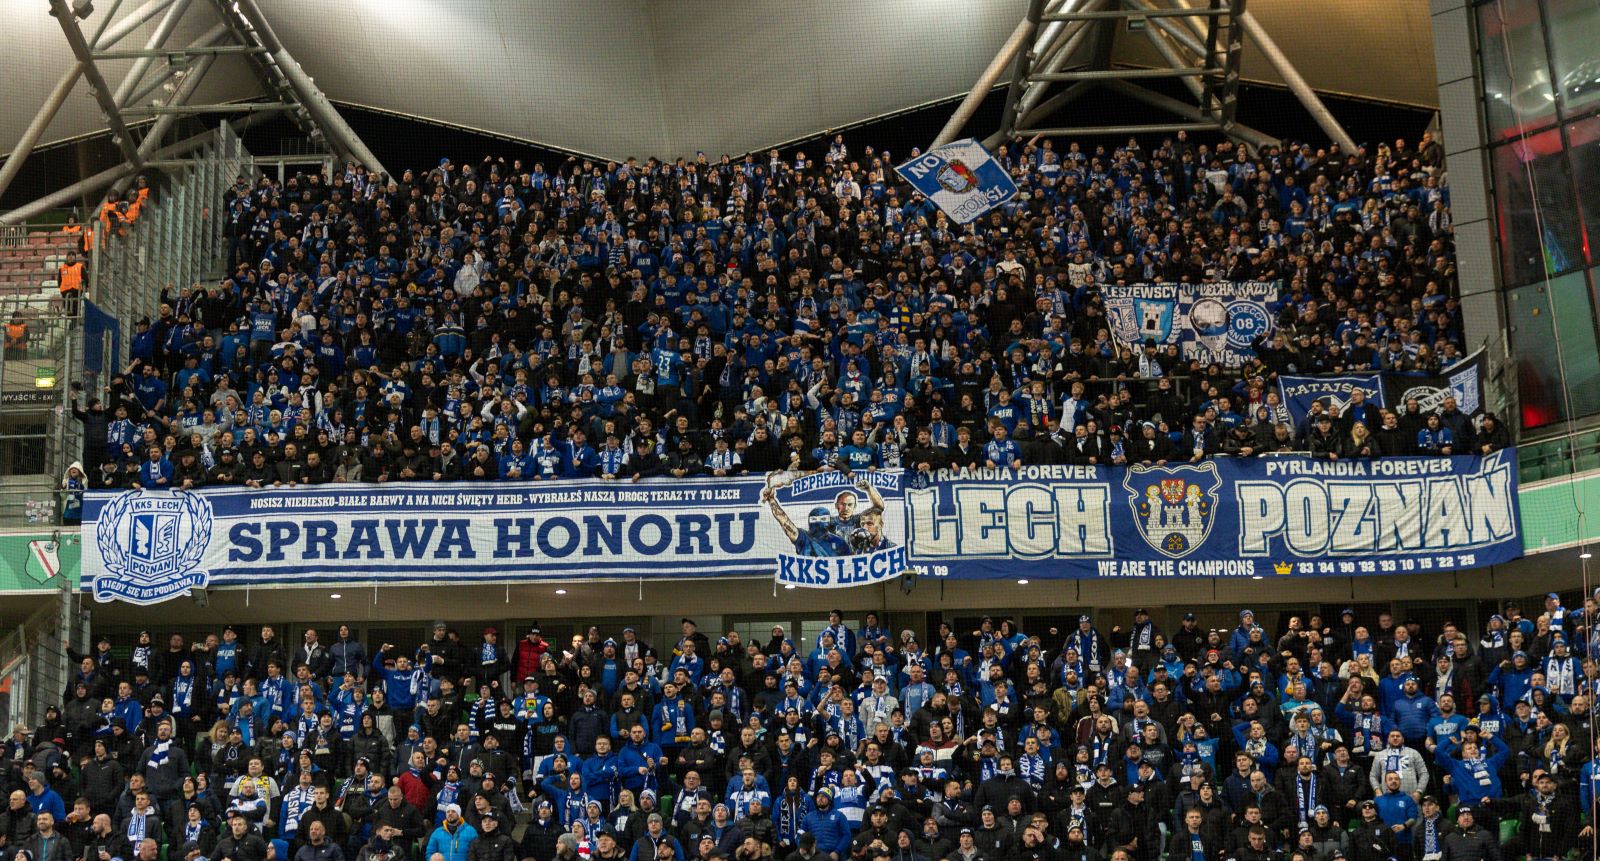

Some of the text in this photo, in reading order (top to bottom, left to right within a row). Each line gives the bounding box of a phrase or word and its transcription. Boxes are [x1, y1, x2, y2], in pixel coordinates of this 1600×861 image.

[1236, 318, 1254, 330] 08
[658, 355, 671, 373] 23
[928, 465, 1098, 482] YRLANDIA FOREVER
[1266, 458, 1453, 476] PYRLANDIA FOREVER
[134, 501, 179, 510] KKS LECH
[250, 497, 283, 509] NOSISZ
[284, 495, 368, 508] NIEBIESKO-BIAŁE
[370, 495, 405, 506] BARWY
[406, 495, 414, 505] A
[415, 495, 430, 505] NA
[431, 494, 455, 505] NICH
[457, 492, 494, 506] ŚWIĘTY
[496, 494, 523, 505] HERB
[529, 490, 582, 504] WYBRAŁEŚ
[584, 490, 616, 504] NASZĄ
[618, 491, 649, 504] DROGĘ
[650, 490, 683, 502] TERAZ
[683, 490, 698, 501] TY
[699, 489, 713, 500] TO
[714, 488, 741, 500] LECH
[1235, 449, 1516, 559] POZNAŃ
[905, 483, 1114, 560] LECH
[228, 511, 760, 562] SPRAWA HONORU
[778, 546, 906, 585] KKS LECH
[932, 565, 949, 577] '09
[1097, 559, 1255, 577] WE ARE THE CHAMPIONS
[1296, 553, 1476, 574] '83 '84 '90 '92 '93 '10 '15 '22 '25
[101, 579, 125, 593] NIGDY
[127, 586, 139, 598] SIĘ
[1481, 720, 1500, 728] ECH
